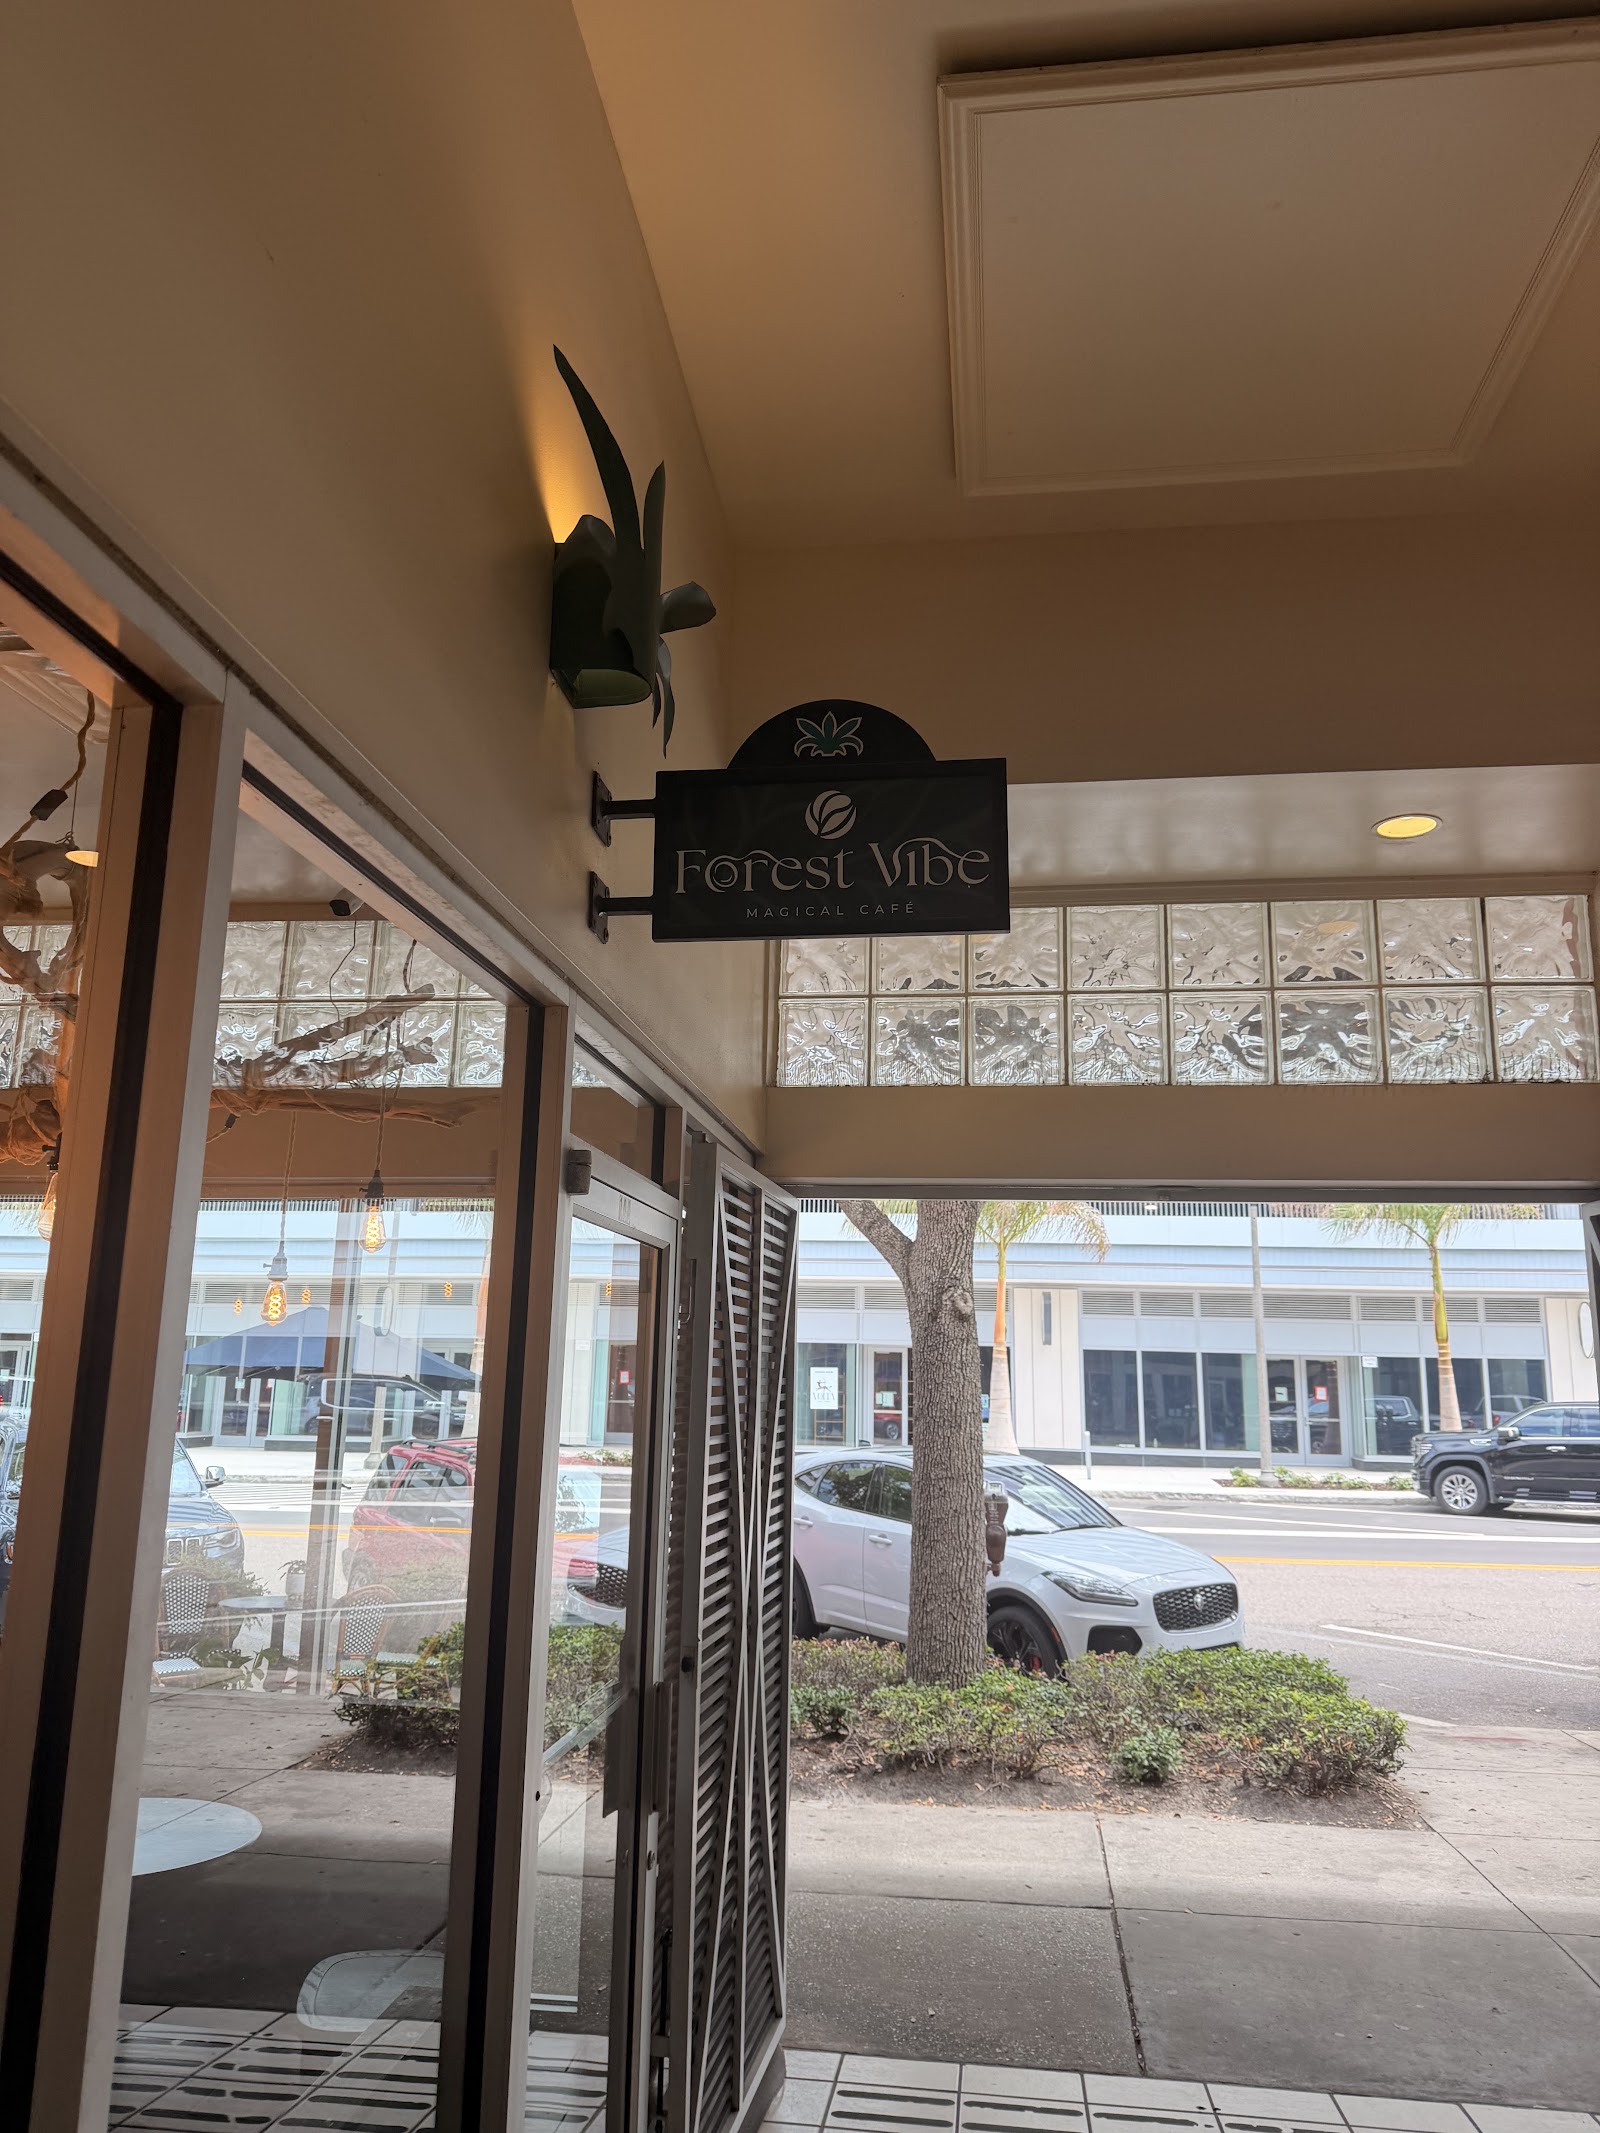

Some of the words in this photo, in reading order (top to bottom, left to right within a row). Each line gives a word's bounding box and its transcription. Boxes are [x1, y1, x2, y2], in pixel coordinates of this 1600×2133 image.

[675, 848, 855, 894] Forest
[868, 837, 990, 889] Vibe
[746, 905, 845, 917] MAGICAL
[859, 901, 916, 916] CAFÉ
